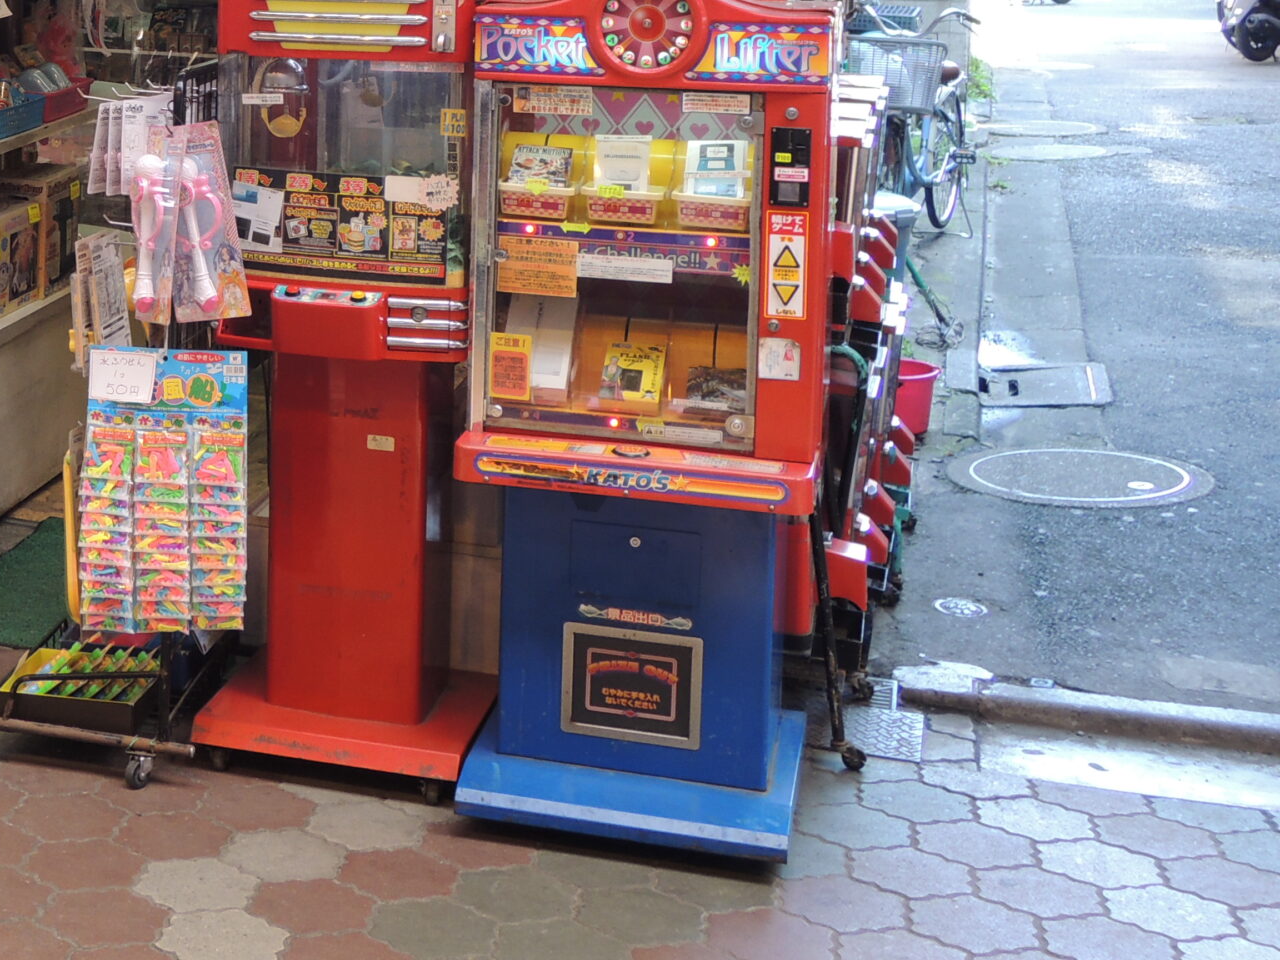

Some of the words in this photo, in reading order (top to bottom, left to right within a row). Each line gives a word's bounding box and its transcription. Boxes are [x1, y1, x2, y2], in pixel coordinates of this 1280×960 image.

[481, 26, 587, 69] Pocket
[716, 34, 820, 74] Lifter
[289, 175, 311, 189] 2等
[341, 179, 365, 193] 3等
[772, 214, 803, 224] 続けて
[772, 224, 803, 232] ゲーム
[627, 232, 634, 241] 2
[106, 383, 139, 396] 50円
[584, 467, 671, 492] KATO'S
[607, 607, 662, 626] 景品出口
[602, 687, 661, 702] むやみに手を入れ
